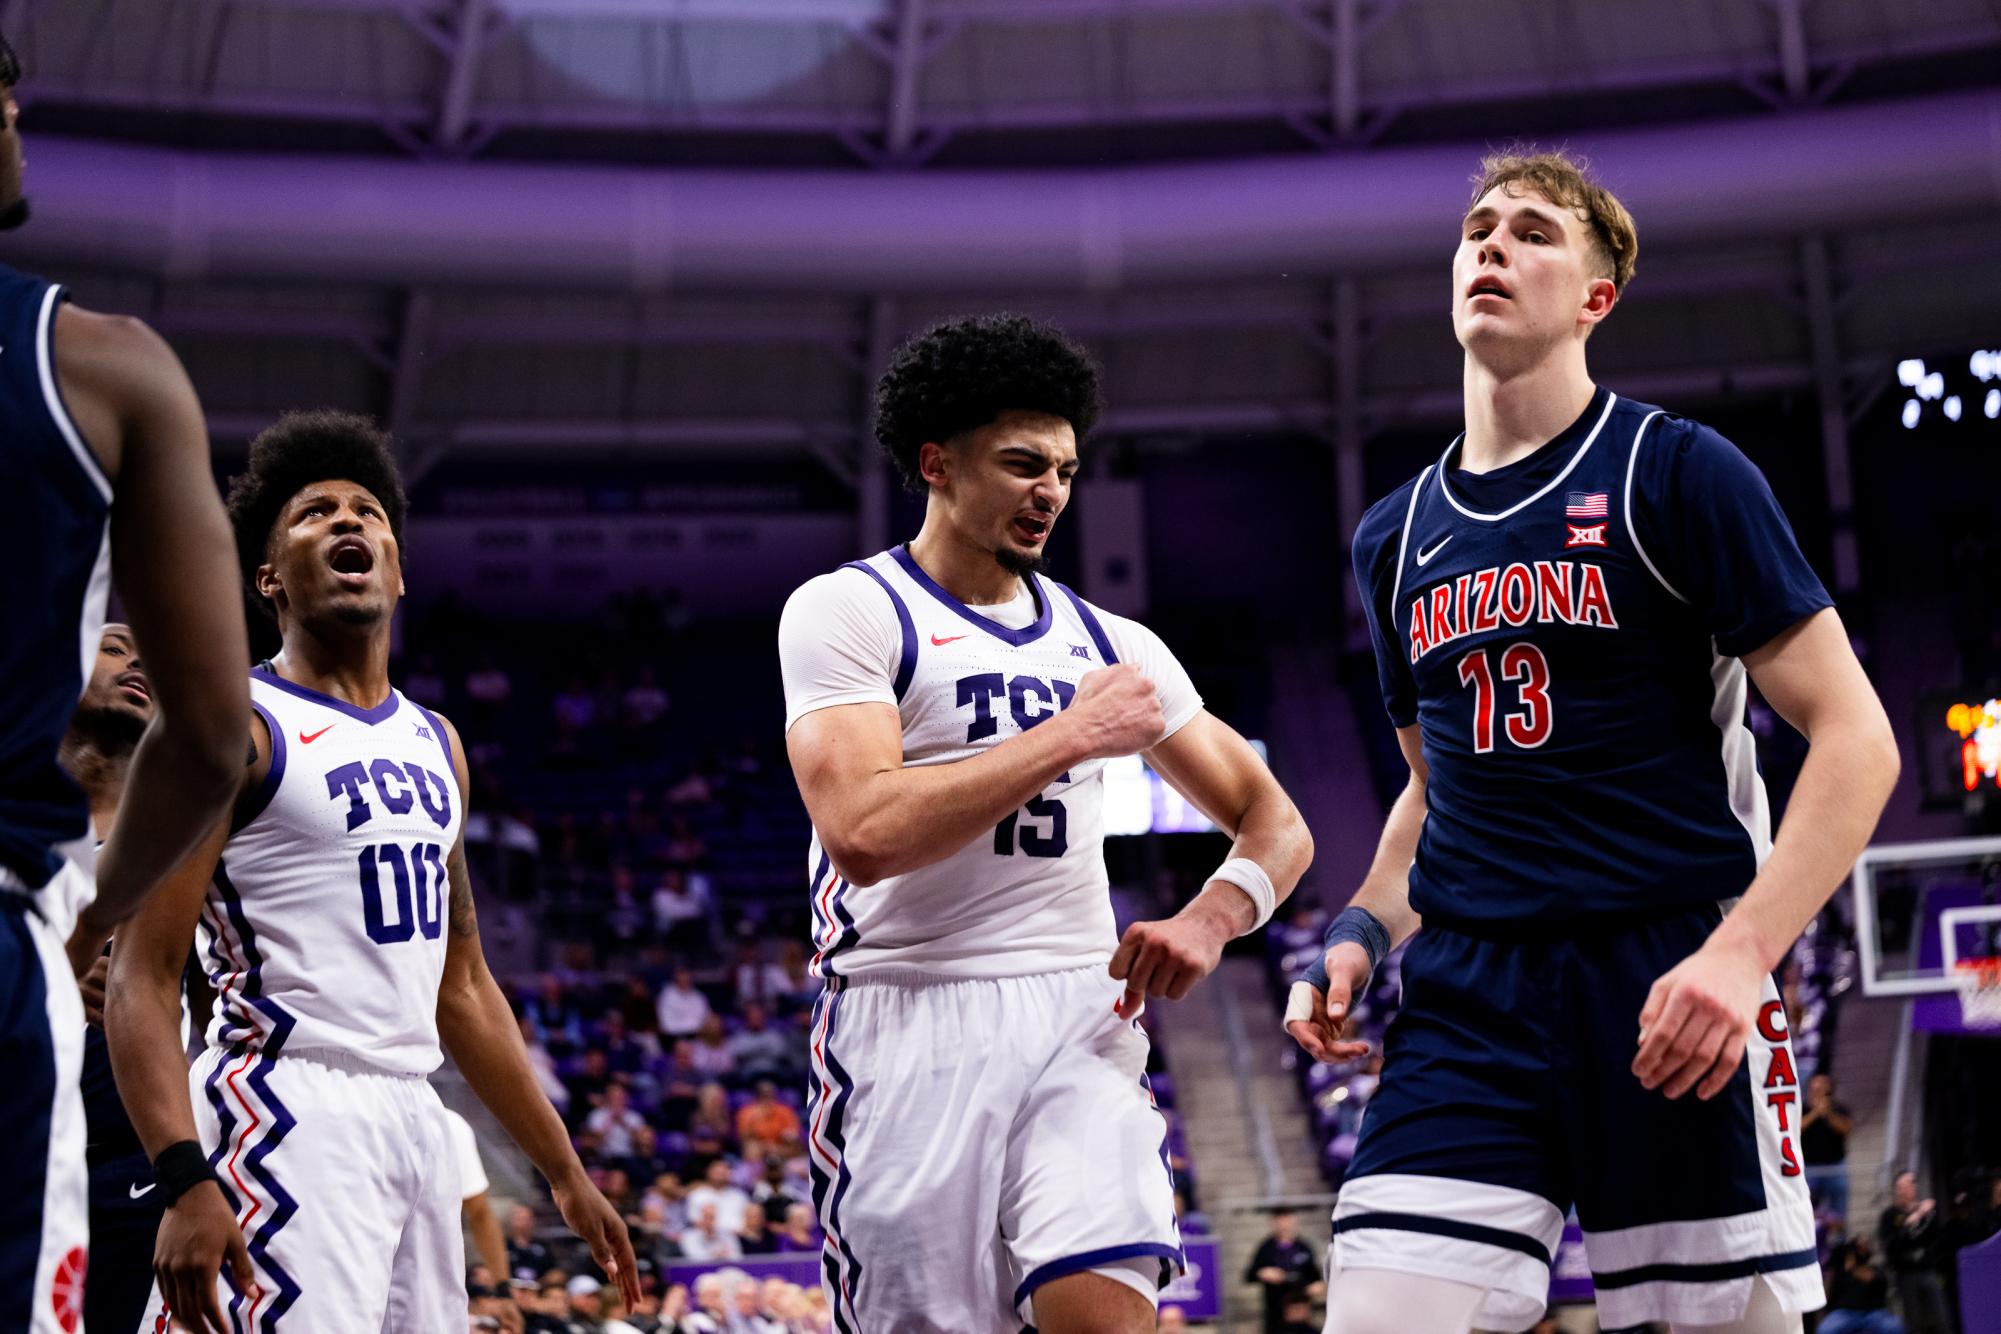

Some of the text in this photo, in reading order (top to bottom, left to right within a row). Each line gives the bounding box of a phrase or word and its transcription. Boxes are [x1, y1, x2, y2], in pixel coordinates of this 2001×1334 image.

[1409, 561, 1619, 665] ARIZONA
[1457, 641, 1553, 754] 13
[325, 759, 452, 832] TCU
[357, 842, 446, 945] 00
[1757, 1000, 1801, 1177] CATS
